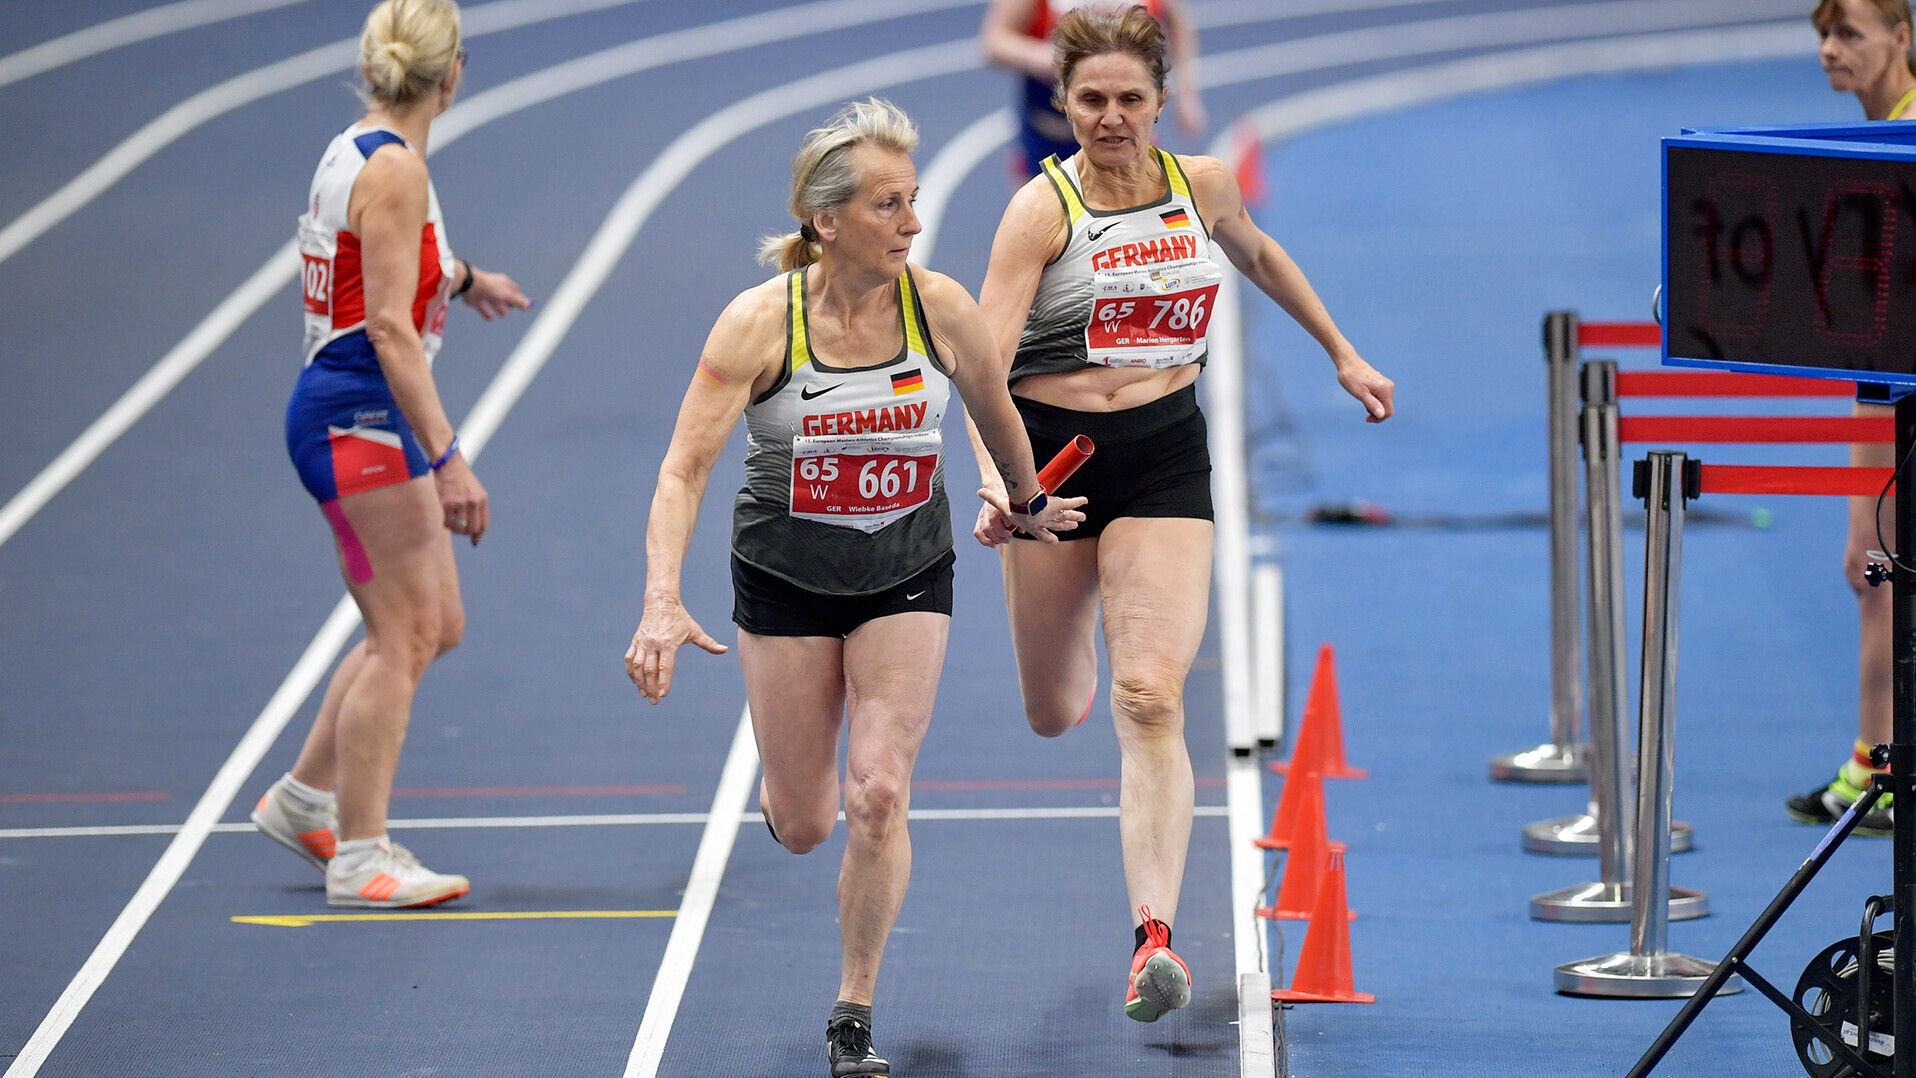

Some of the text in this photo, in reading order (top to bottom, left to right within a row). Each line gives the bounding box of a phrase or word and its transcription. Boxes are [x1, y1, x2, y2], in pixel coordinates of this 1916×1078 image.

[1092, 235, 1196, 272] GERMANY
[1098, 293, 1206, 330] 65 786
[1104, 319, 1121, 333] W
[1116, 337, 1130, 345] GER
[802, 401, 928, 437] GERMANY
[800, 457, 918, 499] 65 661
[810, 484, 829, 500] W
[876, 502, 900, 511] Baseda
